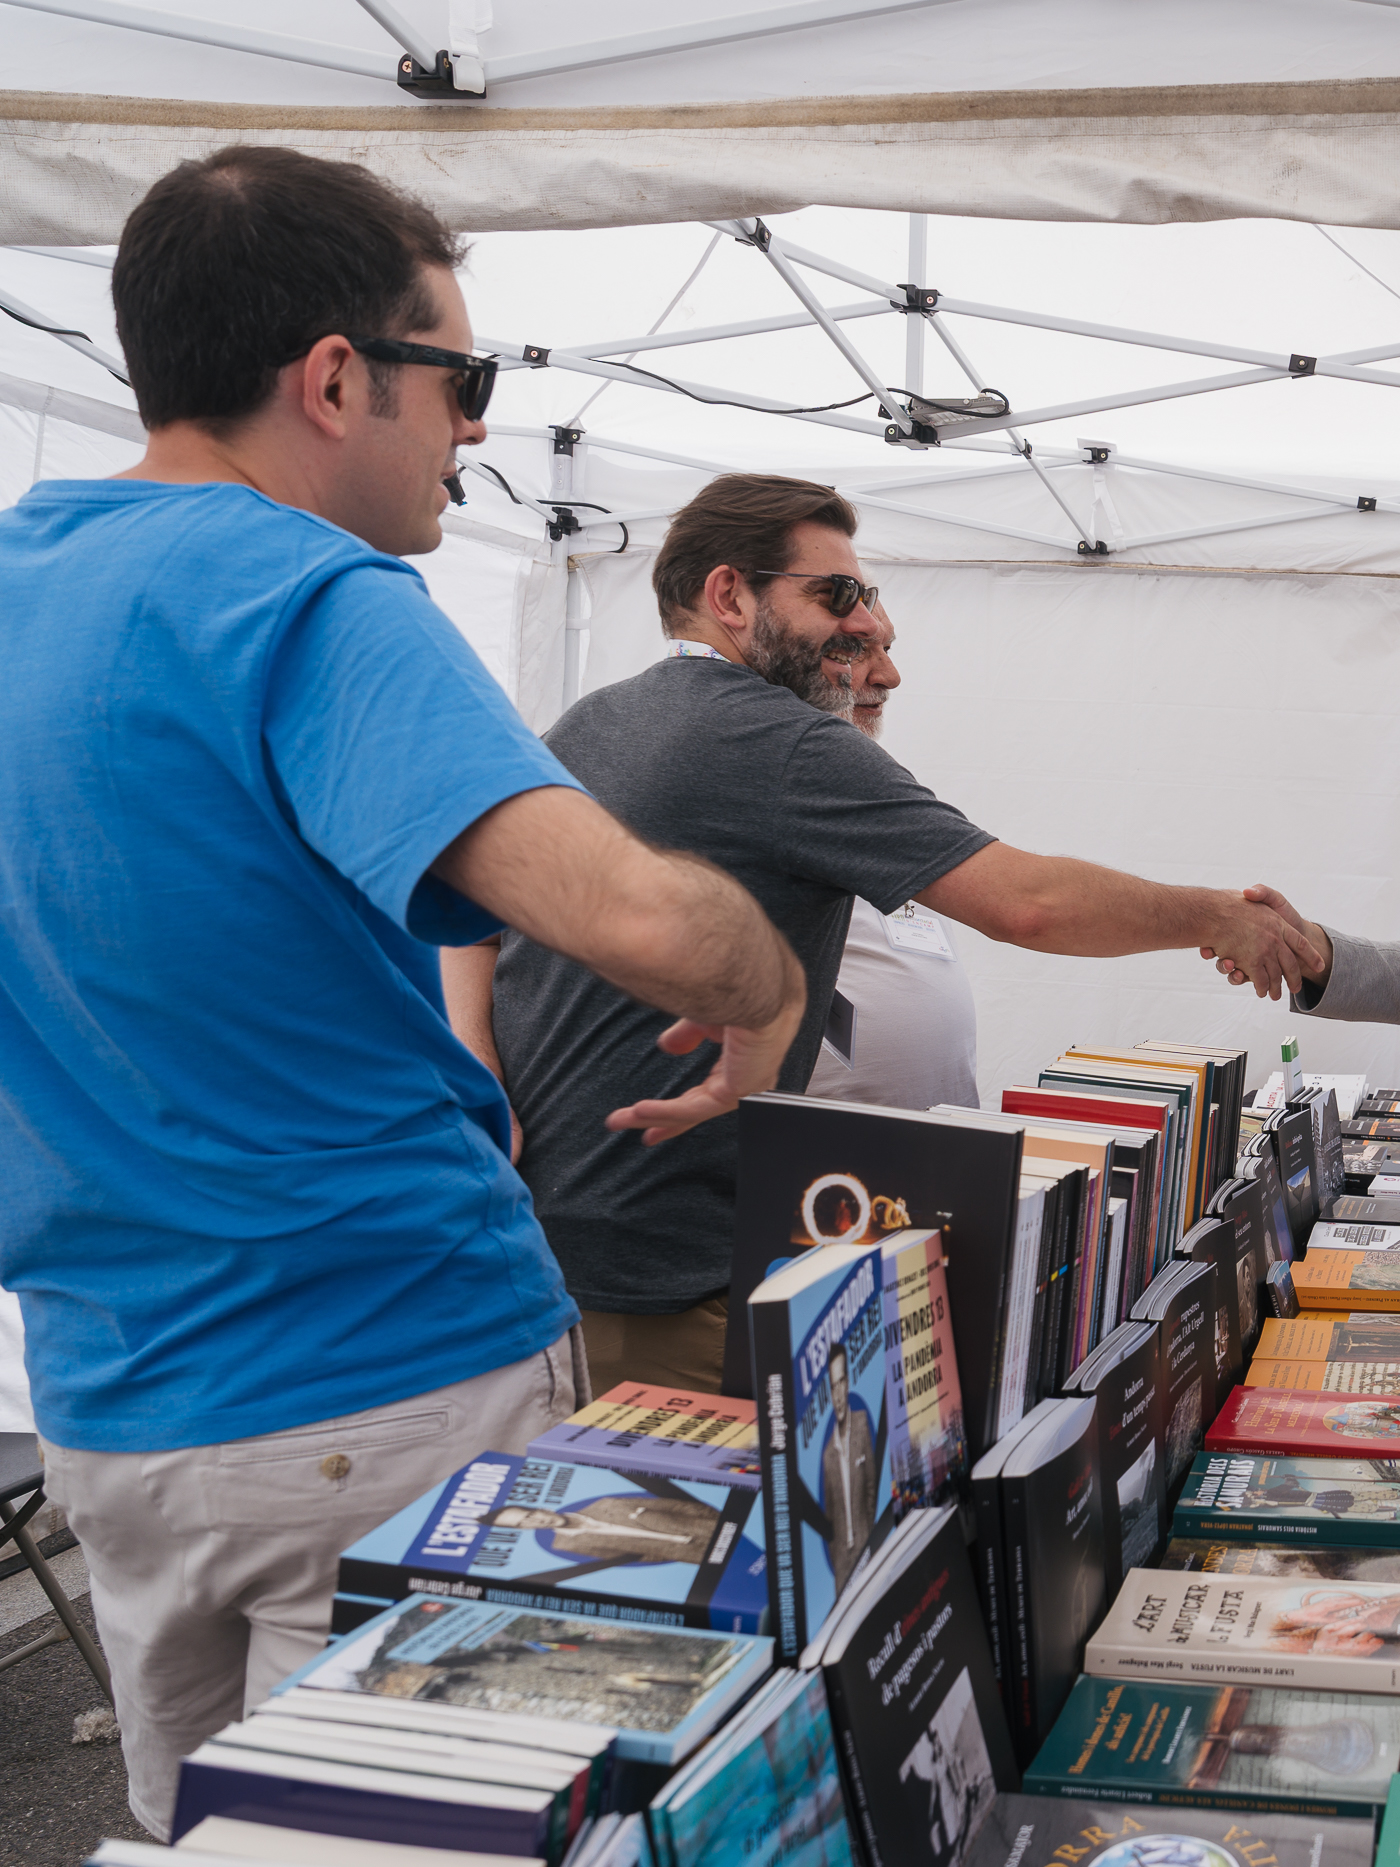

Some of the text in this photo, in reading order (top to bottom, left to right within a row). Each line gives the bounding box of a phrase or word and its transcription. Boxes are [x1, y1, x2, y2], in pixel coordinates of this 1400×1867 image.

[800, 1258, 875, 1398] L'ESTAFADOR
[884, 1295, 946, 1352] DIVENDRES 13
[892, 1336, 943, 1383] LA PANDÈMIA
[905, 1364, 943, 1403] ANDORRA
[1124, 1377, 1144, 1402] Andorra
[606, 1406, 681, 1448] DIVENDRES
[667, 1398, 695, 1408] 13
[692, 1414, 741, 1444] ANDORRA
[770, 1419, 788, 1451] Jorge
[1244, 1405, 1268, 1428] HISTÒRIA
[517, 1461, 555, 1480] REI
[1245, 1448, 1265, 1456] GASCÓN
[507, 1481, 545, 1505] SER
[1194, 1458, 1228, 1507] HISTÒRIA DELS
[1215, 1459, 1255, 1509] SAMURAIS
[420, 1462, 511, 1557] L'ESTAFADOR
[1295, 1526, 1318, 1534] HISTÒRIA
[473, 1546, 515, 1568] QUE
[450, 1581, 482, 1600] Jorge
[778, 1589, 798, 1658] L'ESTAFADOR
[1170, 1583, 1211, 1640] MUSICAR
[1210, 1590, 1244, 1634] FUSTA
[867, 1631, 896, 1681] Recull
[891, 1641, 925, 1698] pagesos
[925, 1603, 953, 1652] pastors
[1117, 1657, 1296, 1676] L'ART DE MUSICAR LA FUSTA Sergi Mas Balaguer
